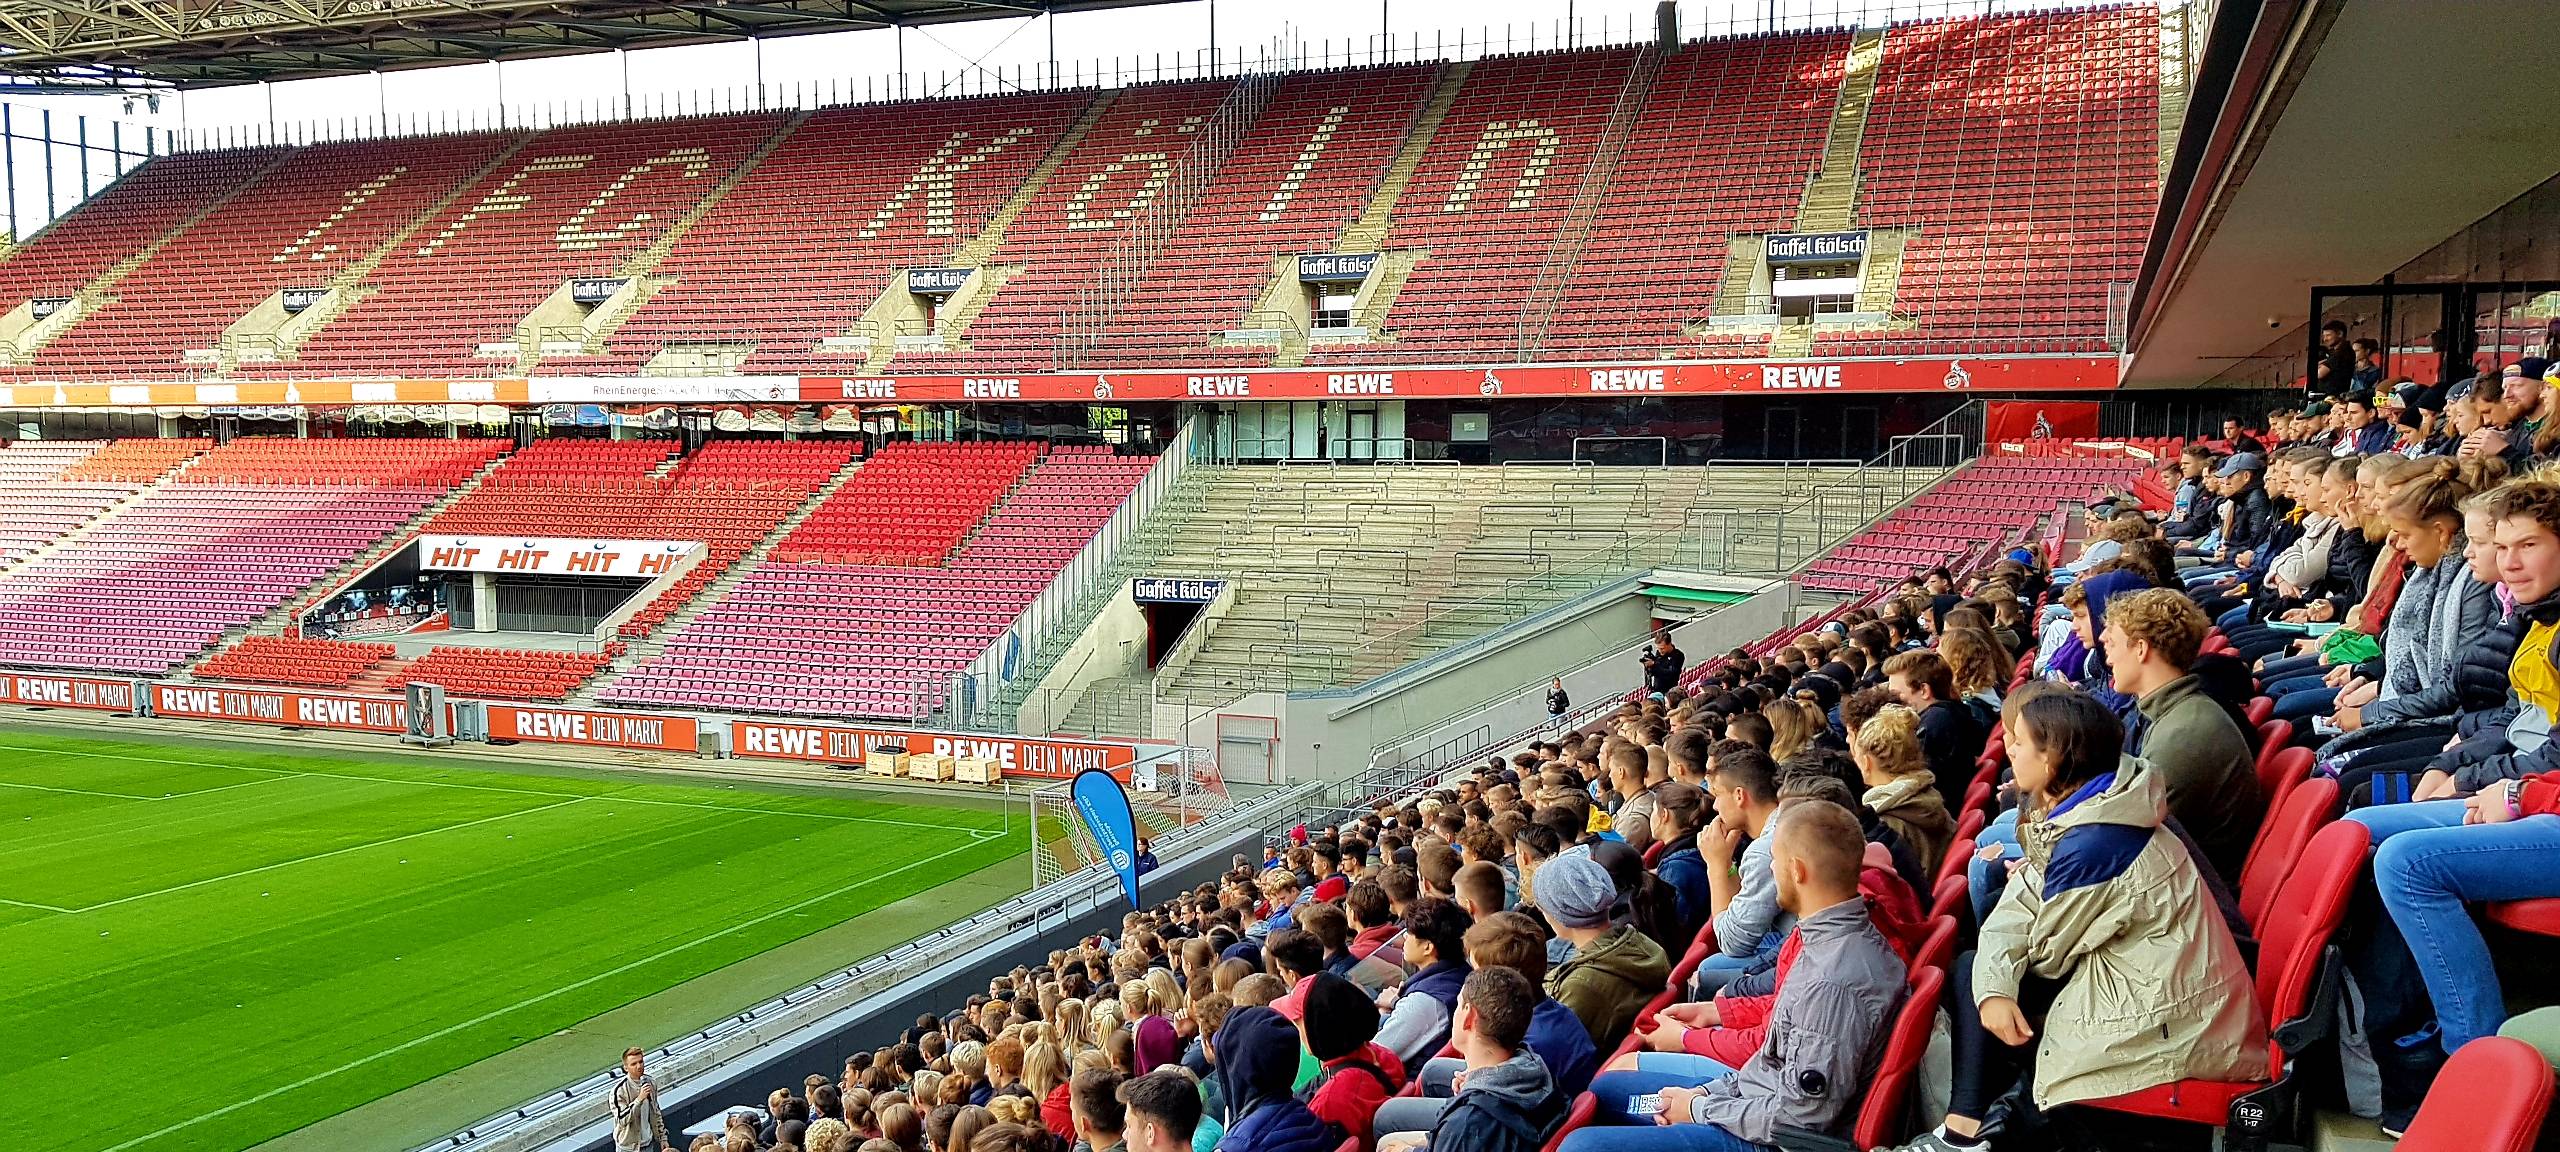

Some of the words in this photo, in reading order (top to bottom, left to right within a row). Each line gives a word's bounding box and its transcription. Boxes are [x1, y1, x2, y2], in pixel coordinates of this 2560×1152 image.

[416, 146, 711, 258] FC
[1768, 238, 1813, 257] Gaffel
[1815, 235, 1865, 255] Kölsch
[1300, 258, 1337, 275] Gaffel
[573, 282, 601, 297] Gaffel
[910, 272, 941, 288] Gaffel
[942, 271, 970, 287] Köls
[1187, 376, 1250, 396] REWE
[1327, 373, 1394, 394] REWE
[1590, 369, 1665, 391] REWE
[1761, 365, 1842, 389] REWE
[842, 379, 896, 398] REWE
[963, 378, 1021, 398] REWE
[430, 547, 480, 567] HIT
[497, 549, 549, 569] HIT
[566, 552, 620, 572] HIT
[1135, 579, 1178, 600] Gaffel
[17, 677, 72, 703] REWE
[74, 682, 97, 706] DEIN
[99, 683, 130, 708] MARKT
[161, 687, 221, 714] REWE
[223, 692, 249, 717] DEIN
[250, 694, 284, 719] MARKT
[298, 698, 363, 725] REWE
[366, 702, 392, 727] DEIN
[516, 711, 588, 740] REWE
[592, 716, 620, 742] DEIN
[622, 718, 664, 745] MARKT
[745, 726, 824, 756] REWE
[828, 731, 860, 759] DEIN
[1023, 744, 1056, 773] DEIN
[1061, 746, 1109, 775] MARKT
[2240, 1107, 2249, 1116] R
[2250, 1108, 2263, 1118] 22
